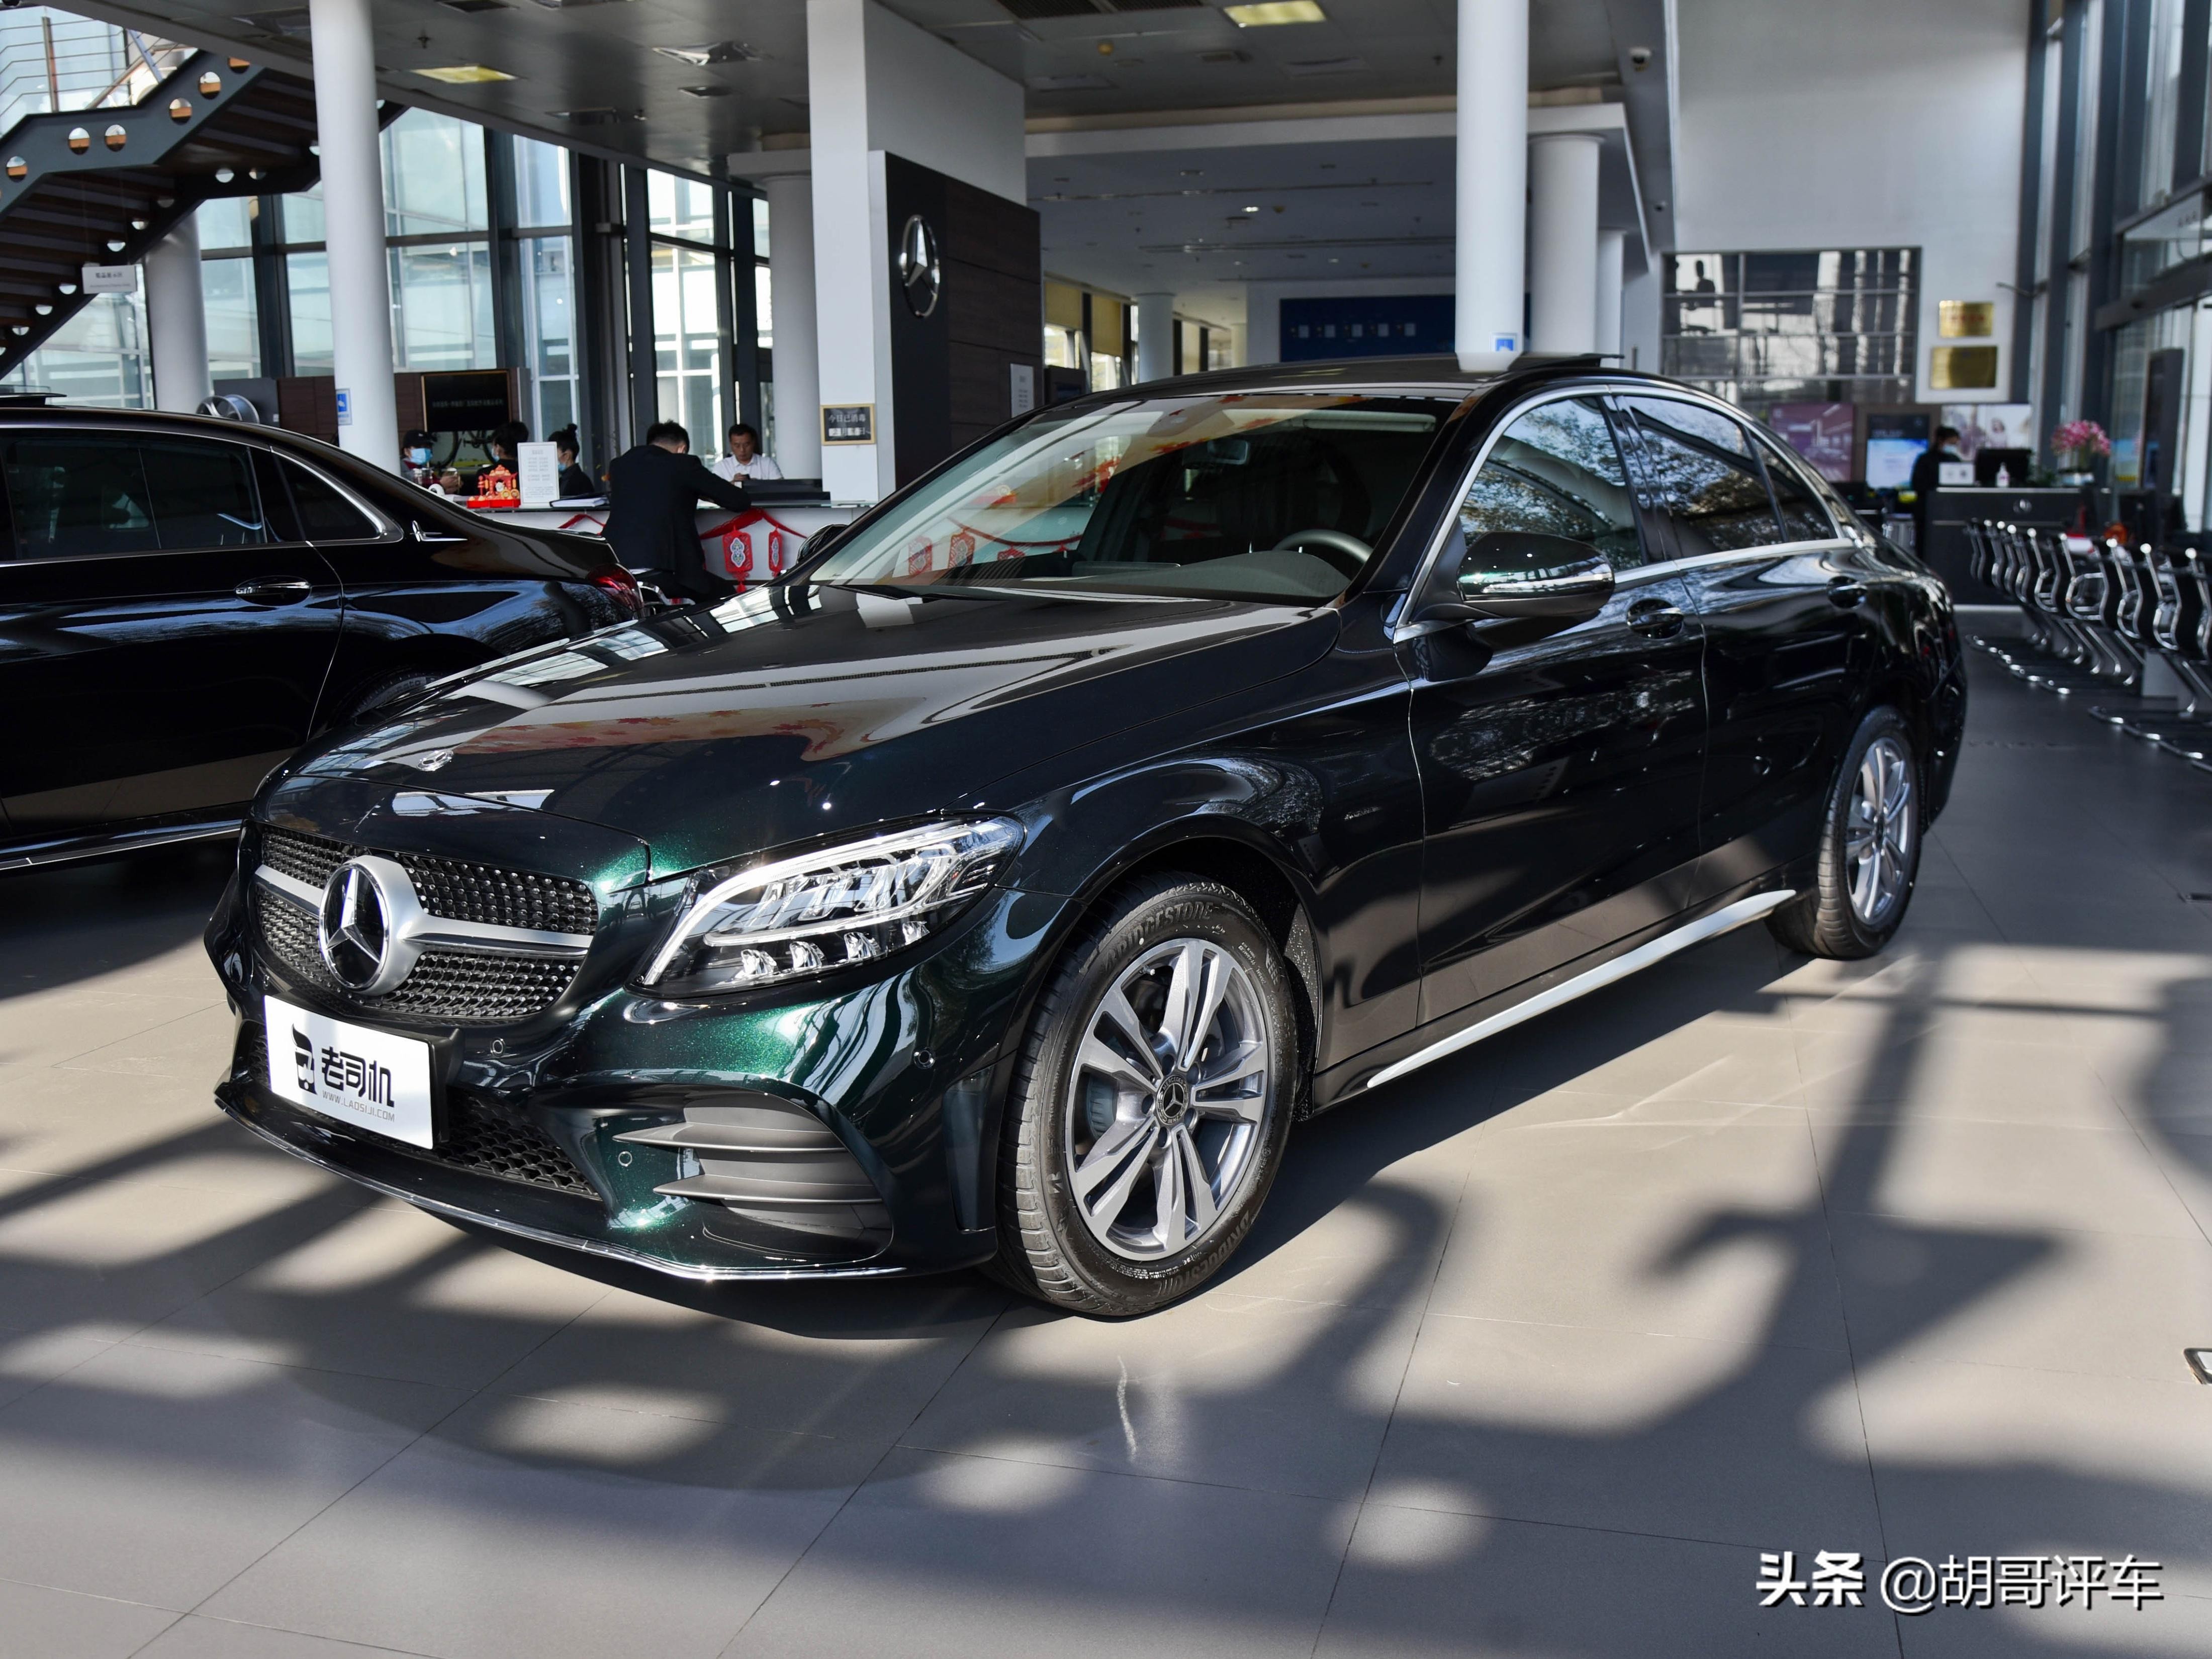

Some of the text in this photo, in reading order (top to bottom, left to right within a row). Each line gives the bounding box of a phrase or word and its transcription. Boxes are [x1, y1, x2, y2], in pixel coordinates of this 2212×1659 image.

[321, 1046, 395, 1108] 老司机
[1162, 1077, 1183, 1090] MERCEDES
[322, 1089, 395, 1122] WWW.LAOSIJI.COM
[1167, 1116, 1179, 1124] BENZ
